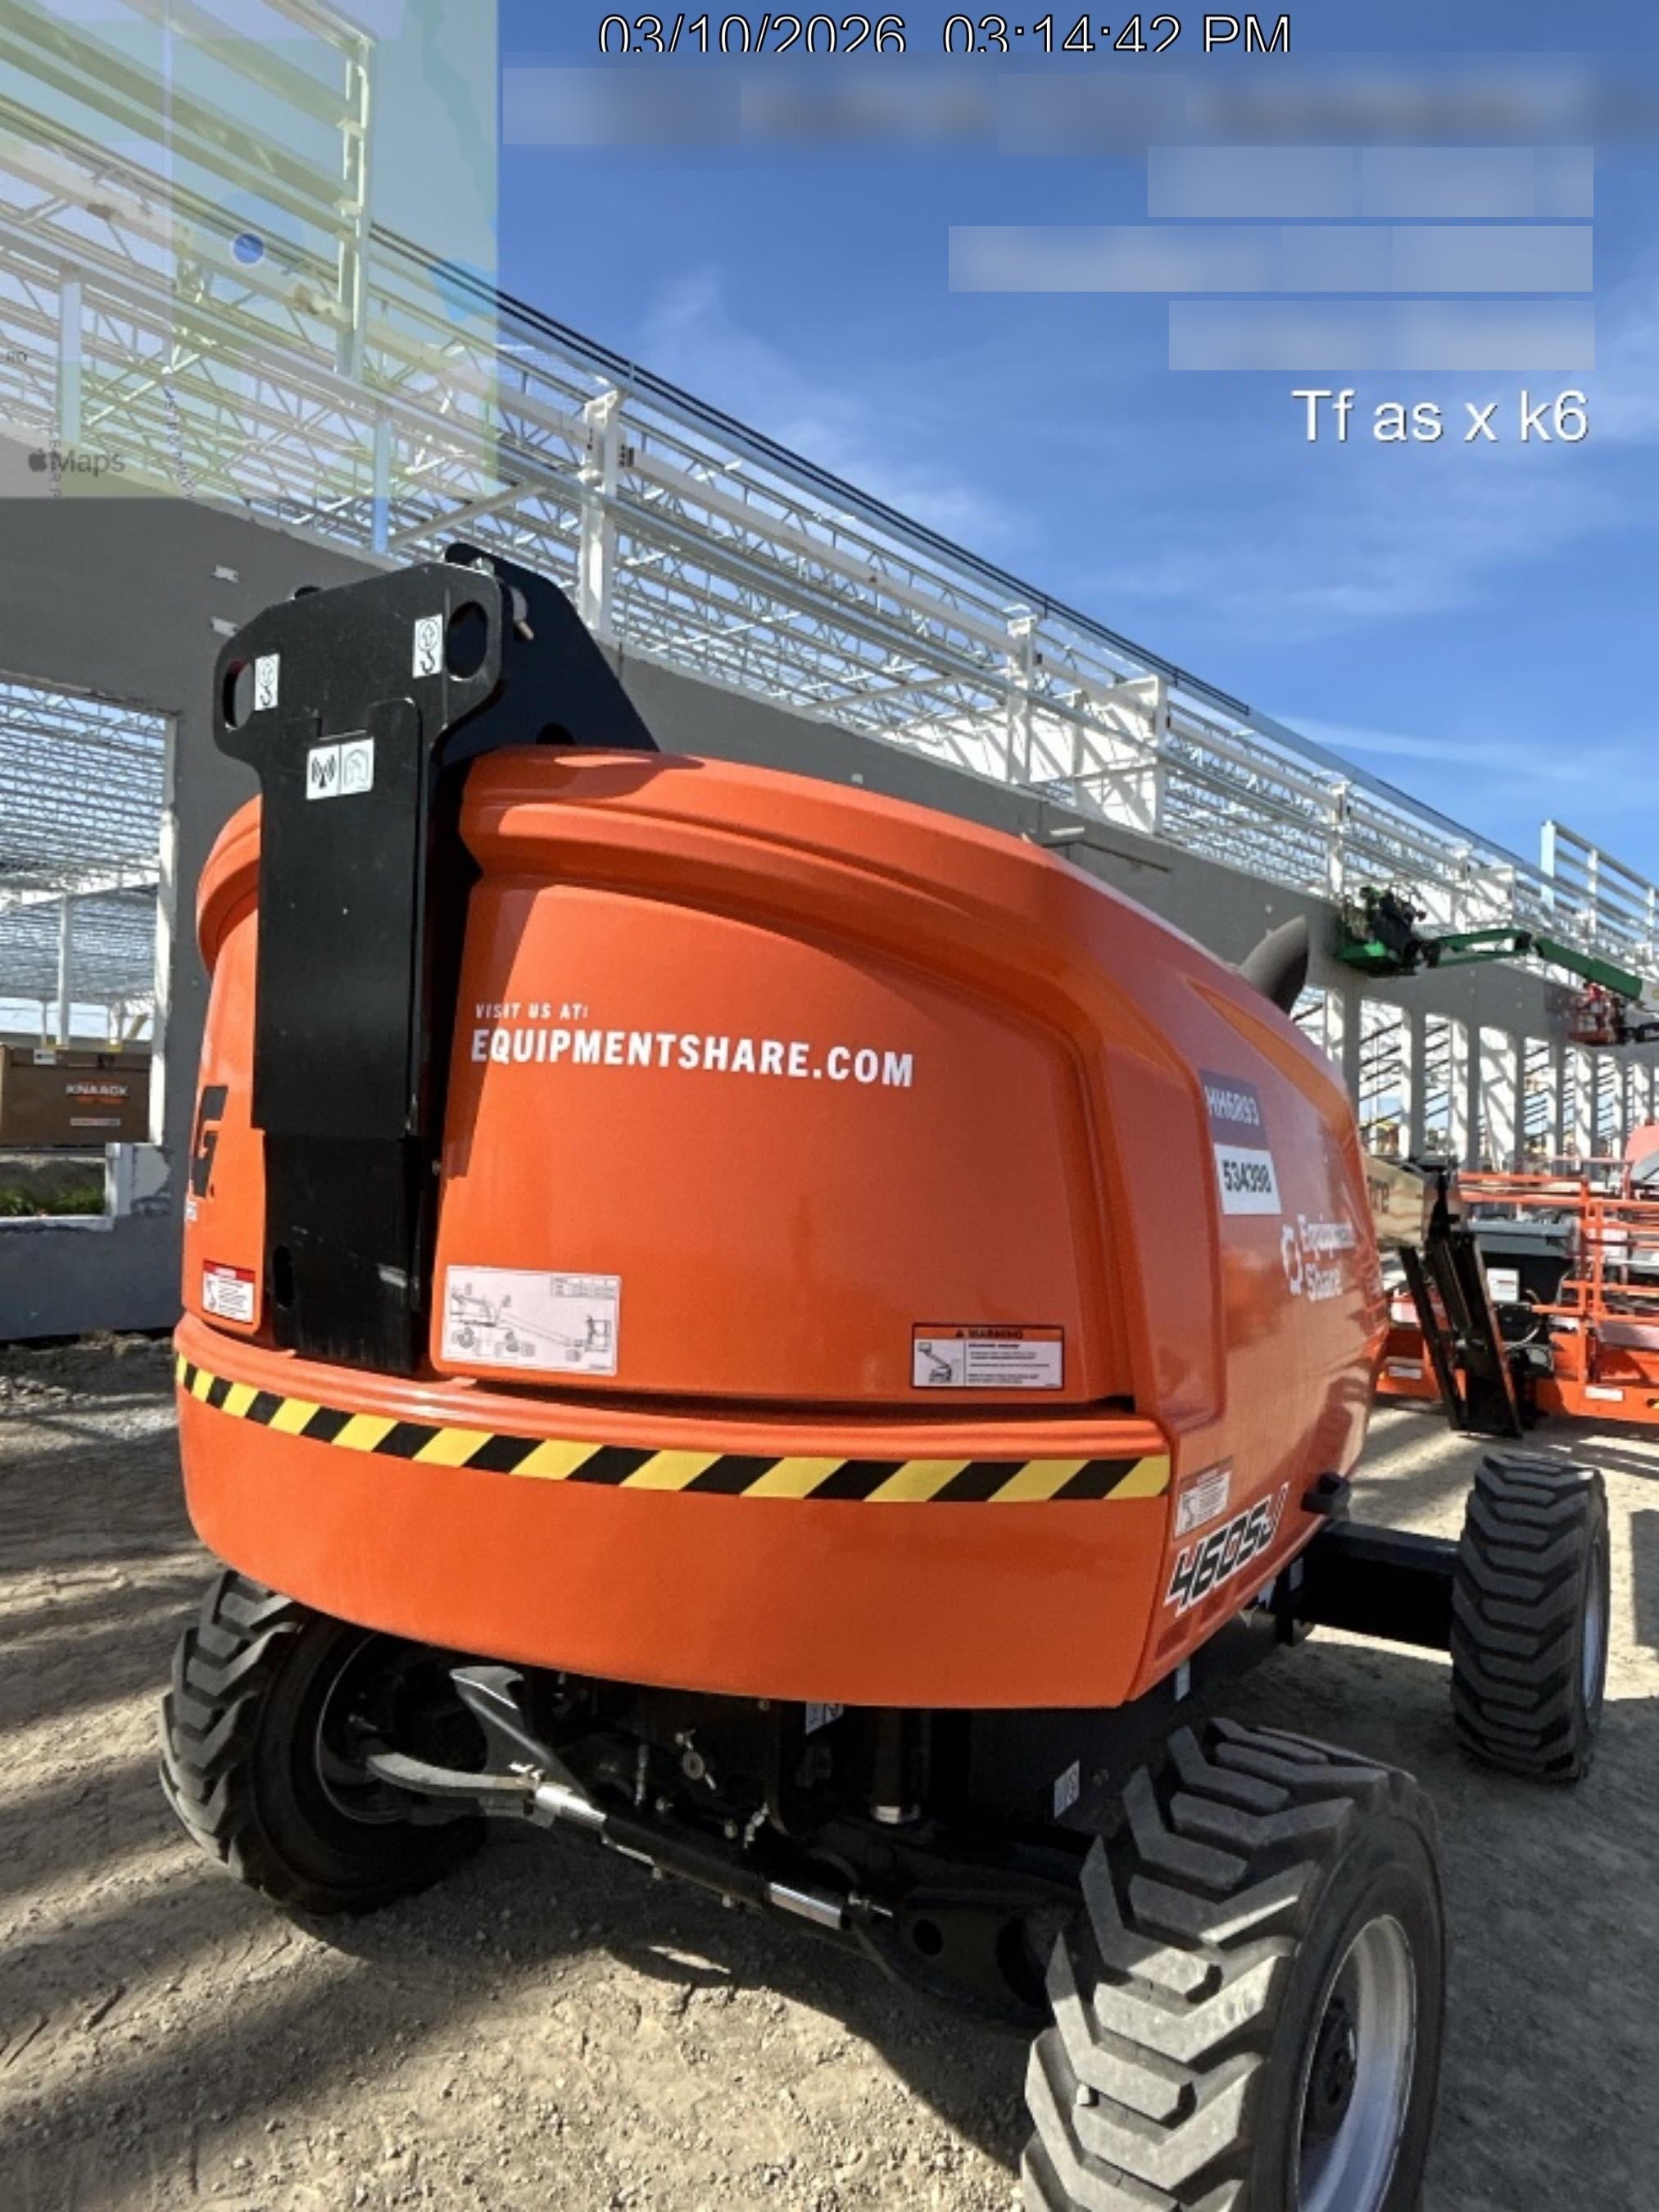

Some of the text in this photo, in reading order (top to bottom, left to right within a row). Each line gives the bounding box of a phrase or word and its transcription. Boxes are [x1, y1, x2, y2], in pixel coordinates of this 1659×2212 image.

[475, 1002, 588, 1020] VISIT US AT:
[471, 1028, 915, 1088] EQUIPMENTSHARE.COM
[66, 1083, 129, 1096] KNAACK
